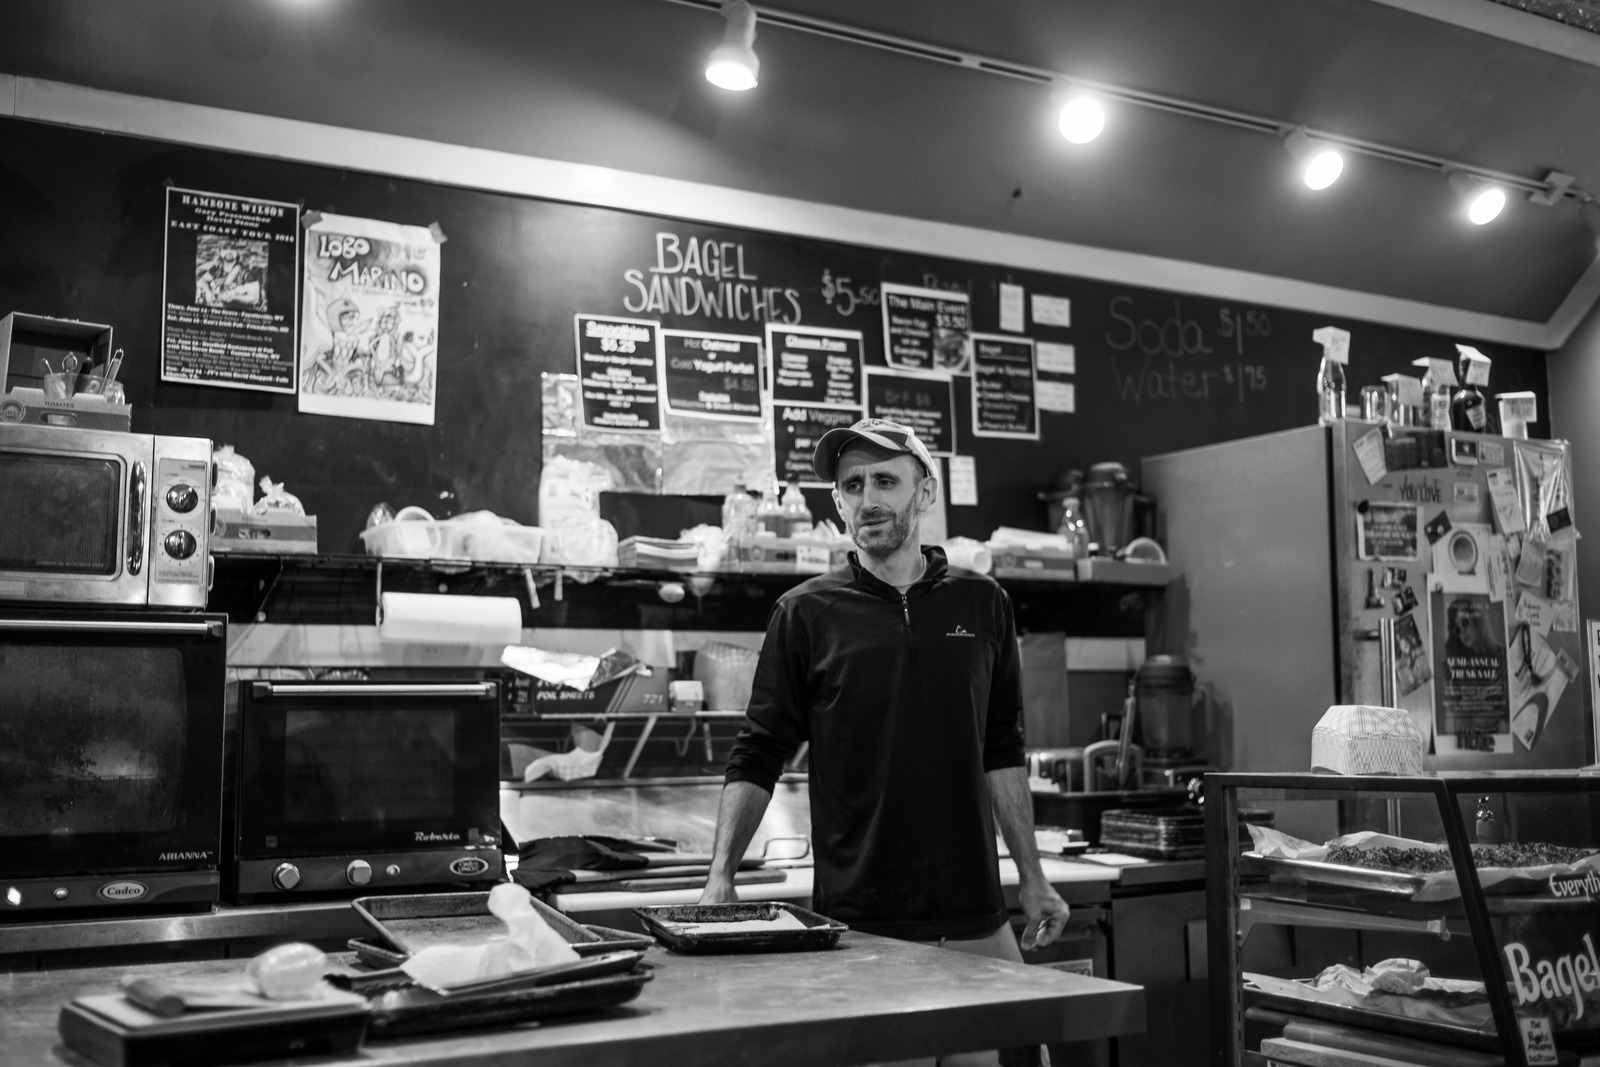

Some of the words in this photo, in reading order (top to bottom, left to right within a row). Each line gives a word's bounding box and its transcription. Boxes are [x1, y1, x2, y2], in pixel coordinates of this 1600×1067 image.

[182, 195, 239, 212] HAMBONE
[241, 203, 284, 218] WILSON
[170, 220, 200, 230] EAST
[203, 224, 238, 236] COAST
[241, 229, 272, 240] TOUR
[319, 234, 371, 260] LOBO
[649, 232, 758, 281] BAGEL
[623, 268, 802, 326] SANDWICHES
[889, 294, 909, 309] The
[909, 297, 936, 312] Main
[936, 300, 966, 315] Event
[585, 320, 651, 343] Smoothies
[1105, 294, 1214, 358] Soda
[700, 338, 741, 353] Oatmeal
[693, 358, 725, 375] Yogurt
[1109, 354, 1220, 403] Water
[44, 400, 76, 409] TOMATES
[782, 406, 808, 421] Add
[1446, 656, 1500, 669] SEMI-ANNUAL
[536, 690, 557, 700] FOIL
[559, 690, 595, 700] SHEETS
[642, 693, 664, 705] 721
[107, 886, 141, 896] Cadco
[1549, 870, 1600, 903] Everyth
